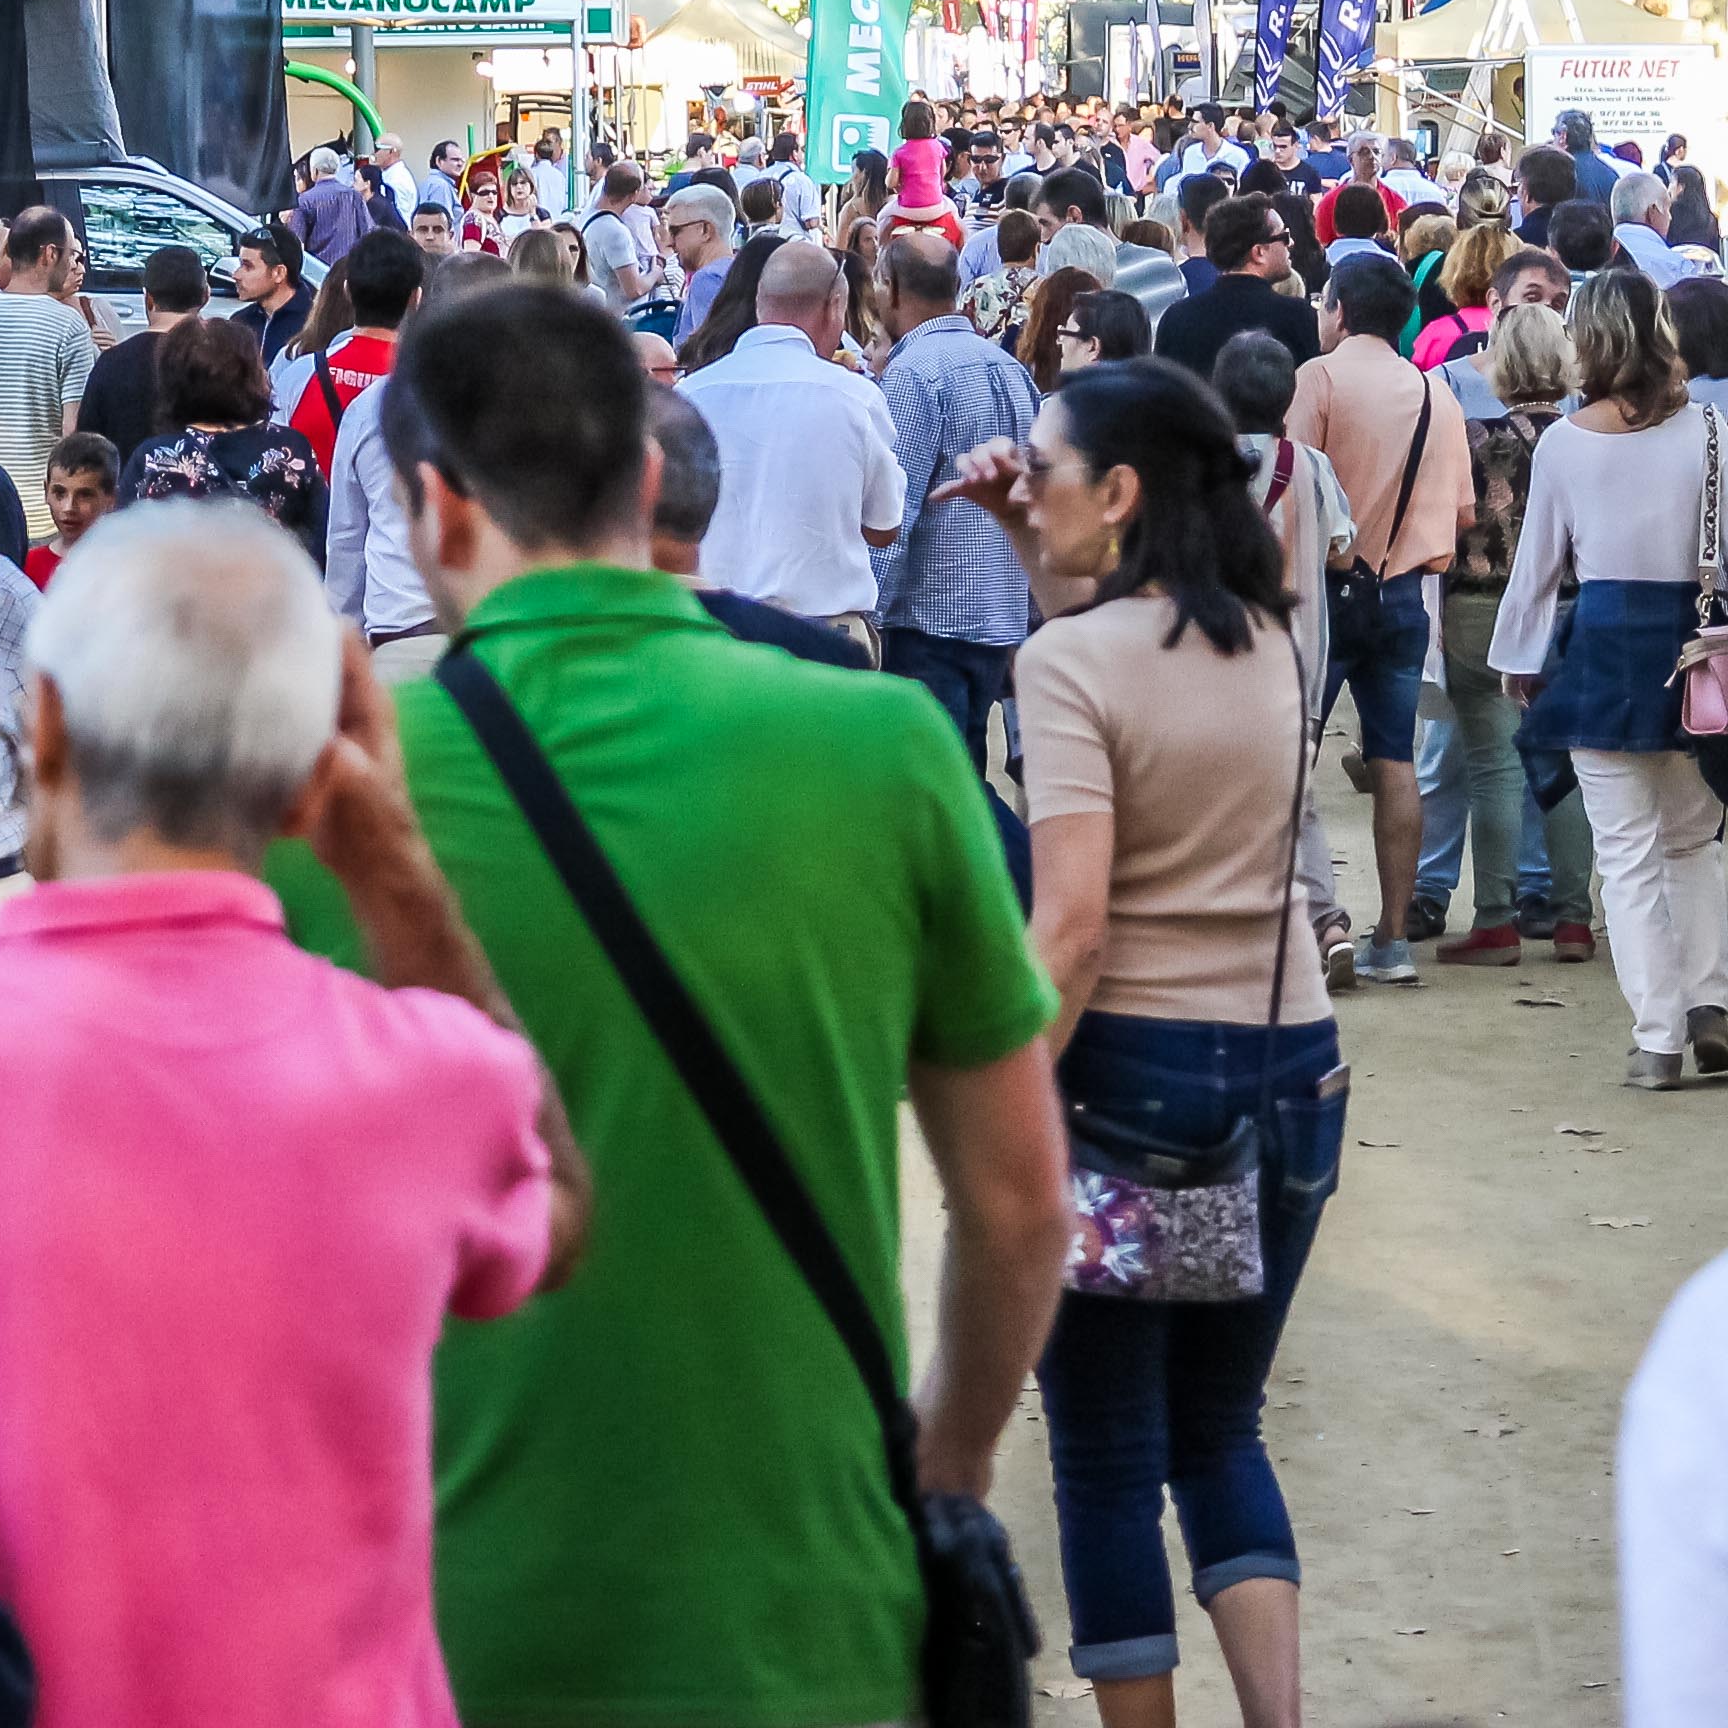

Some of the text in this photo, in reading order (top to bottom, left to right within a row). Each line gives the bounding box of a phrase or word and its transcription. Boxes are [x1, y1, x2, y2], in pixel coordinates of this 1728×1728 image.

[1268, 4, 1287, 40] R.
[1560, 59, 1681, 79] FUTUR NET
[745, 80, 779, 91] STIHL
